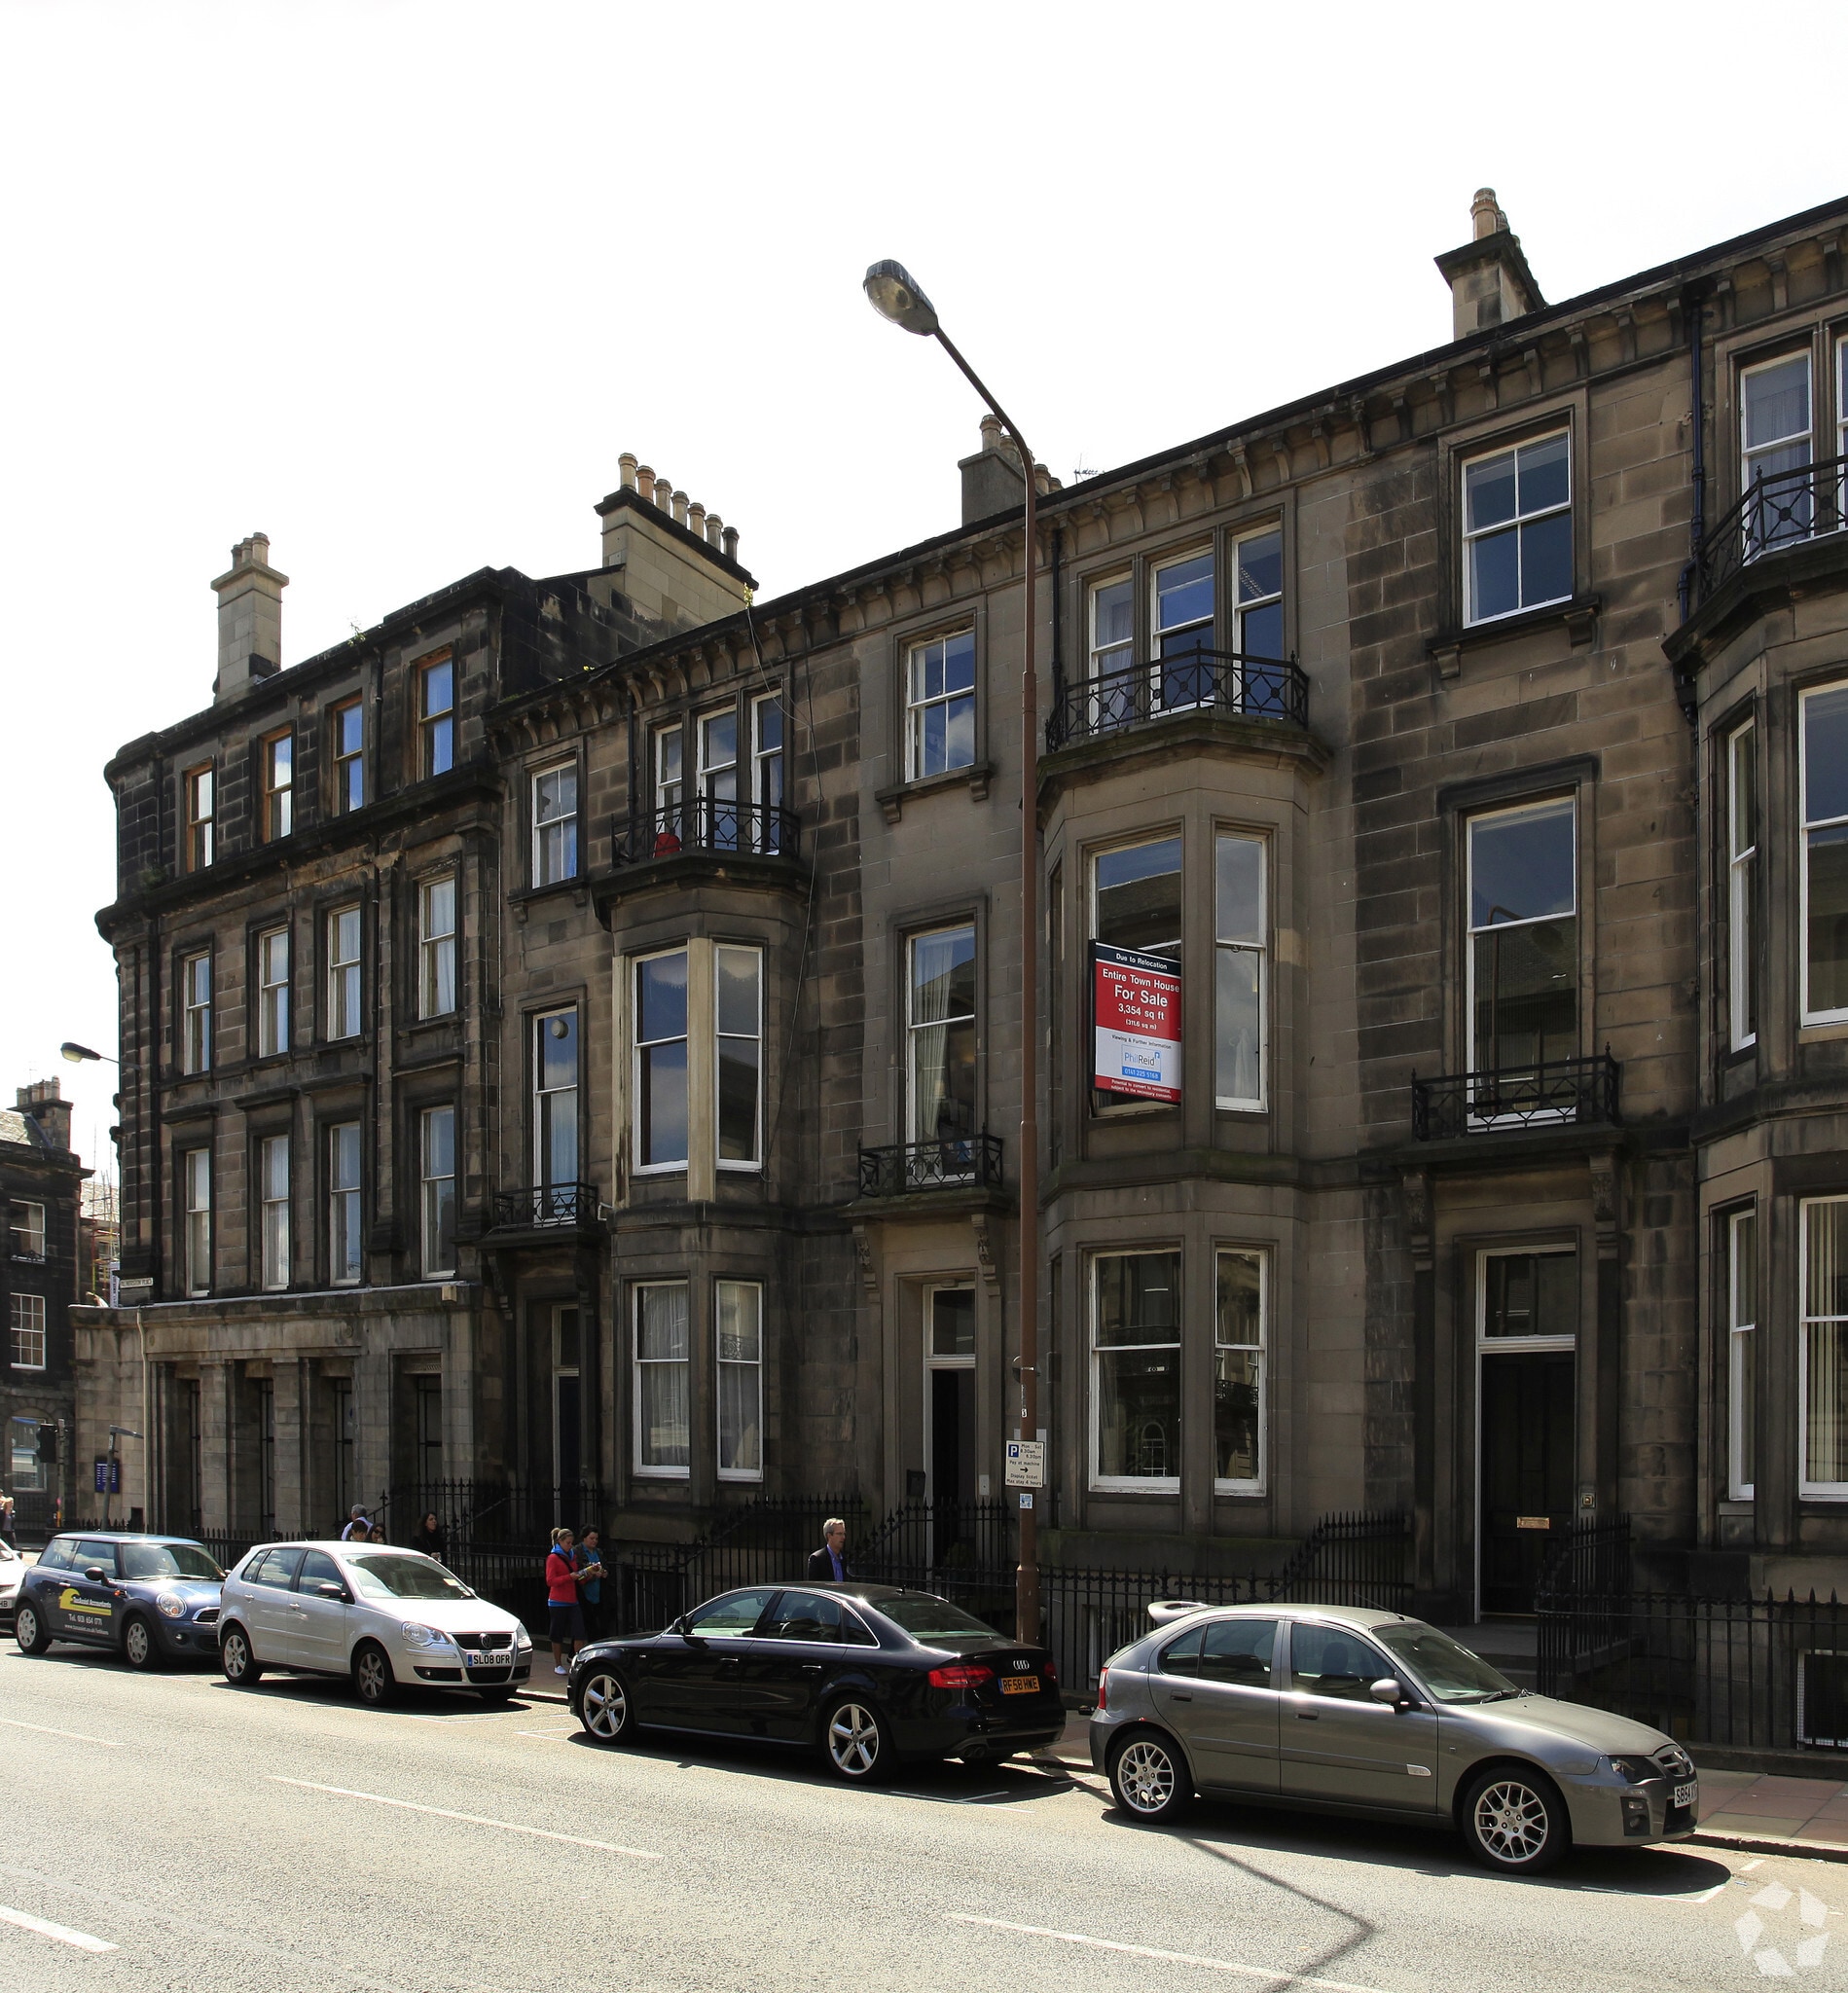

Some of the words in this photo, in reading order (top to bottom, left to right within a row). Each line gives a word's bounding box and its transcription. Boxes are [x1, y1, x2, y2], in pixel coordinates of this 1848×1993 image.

[1116, 953, 1128, 961] Due
[1137, 958, 1168, 970] Relocation
[1103, 968, 1127, 982] Entire
[1130, 974, 1151, 987] Town
[1154, 979, 1180, 993] House
[1114, 984, 1136, 1000] For
[1140, 990, 1168, 1007] Sale
[1118, 1002, 1141, 1016] 3,354
[1143, 1010, 1155, 1020] sq
[1157, 1011, 1165, 1020] ft
[1124, 1052, 1155, 1067] PhilReid
[1010, 1445, 1018, 1457] P
[473, 1654, 494, 1665] SL08
[495, 1654, 511, 1664] OFR
[1002, 1679, 1023, 1692] RF58
